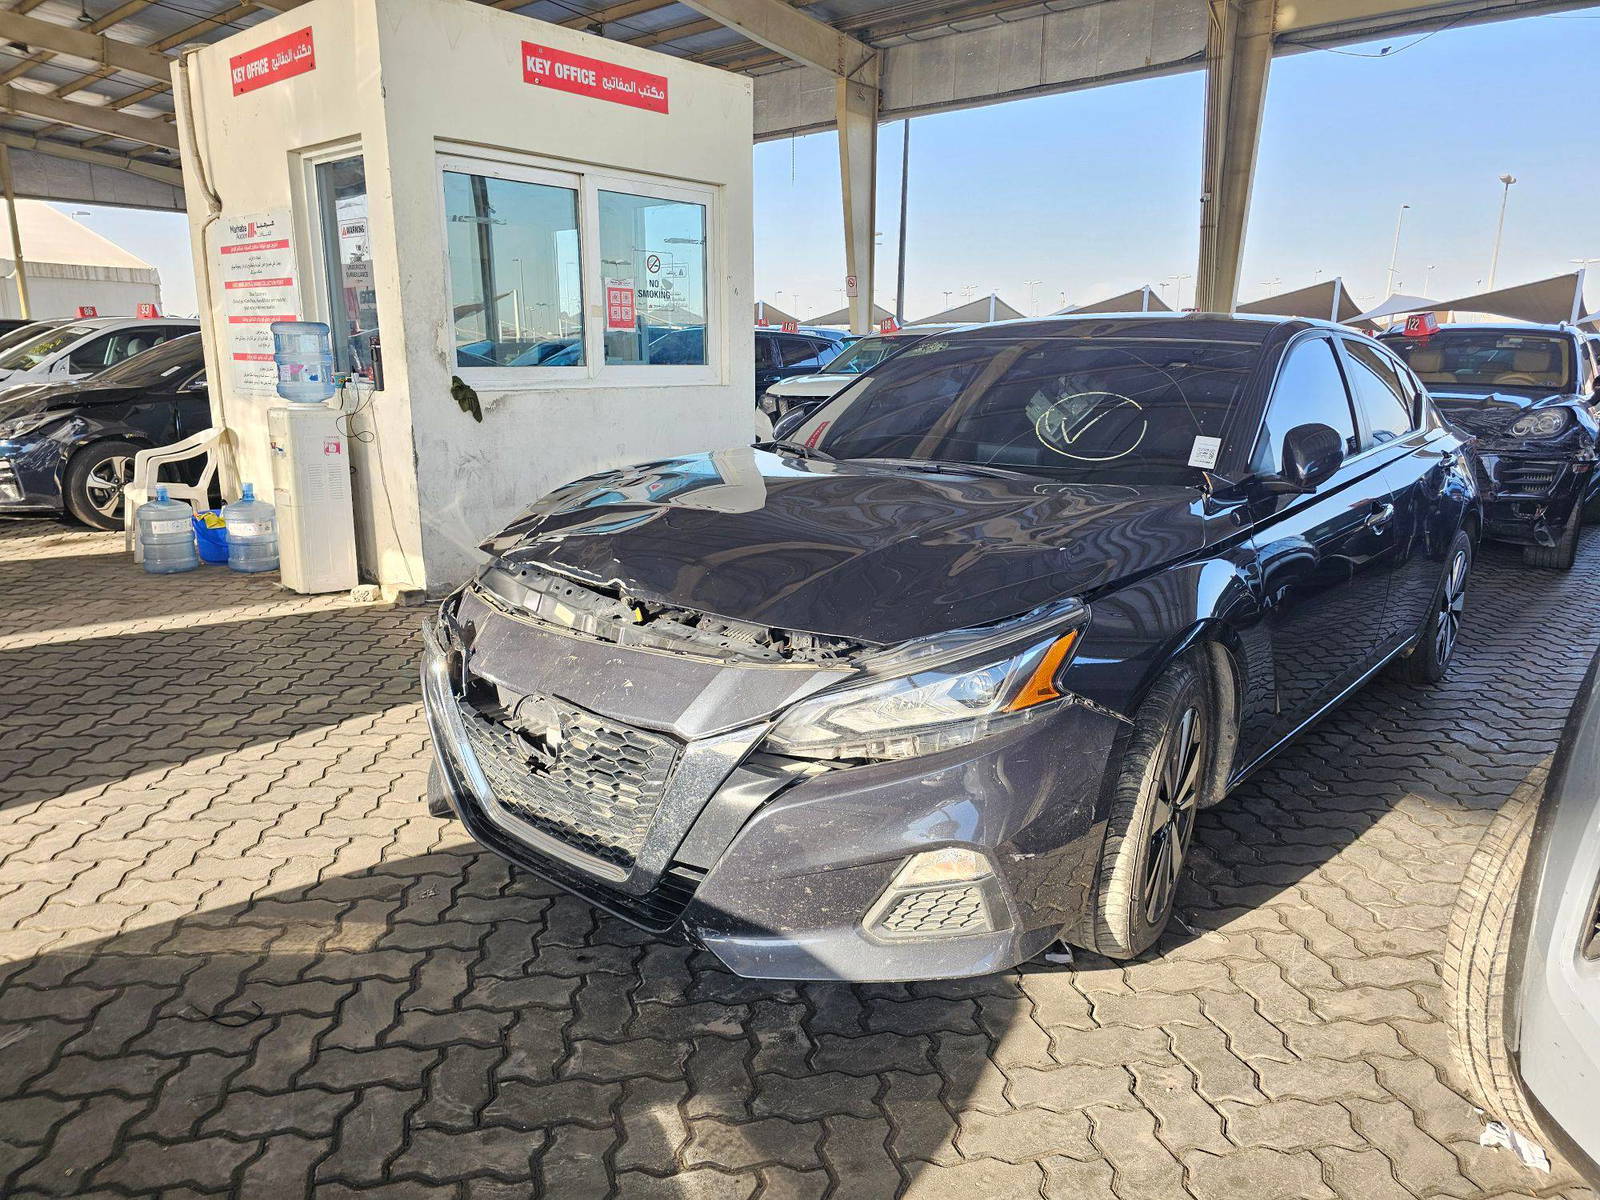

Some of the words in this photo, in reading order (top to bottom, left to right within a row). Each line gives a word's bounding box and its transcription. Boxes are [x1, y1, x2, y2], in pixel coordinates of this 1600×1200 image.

[271, 48, 293, 71] المفاتيح
[293, 43, 312, 62] مكتب
[232, 66, 245, 84] KEY
[246, 57, 270, 79] OFFICE
[526, 55, 552, 75] KEY
[554, 62, 597, 86] OFFICE
[602, 76, 636, 94] المفاتيح
[638, 85, 665, 100] مكتب
[649, 279, 660, 288] NO
[637, 289, 671, 299] SMOKING
[1408, 318, 1420, 331] 122
